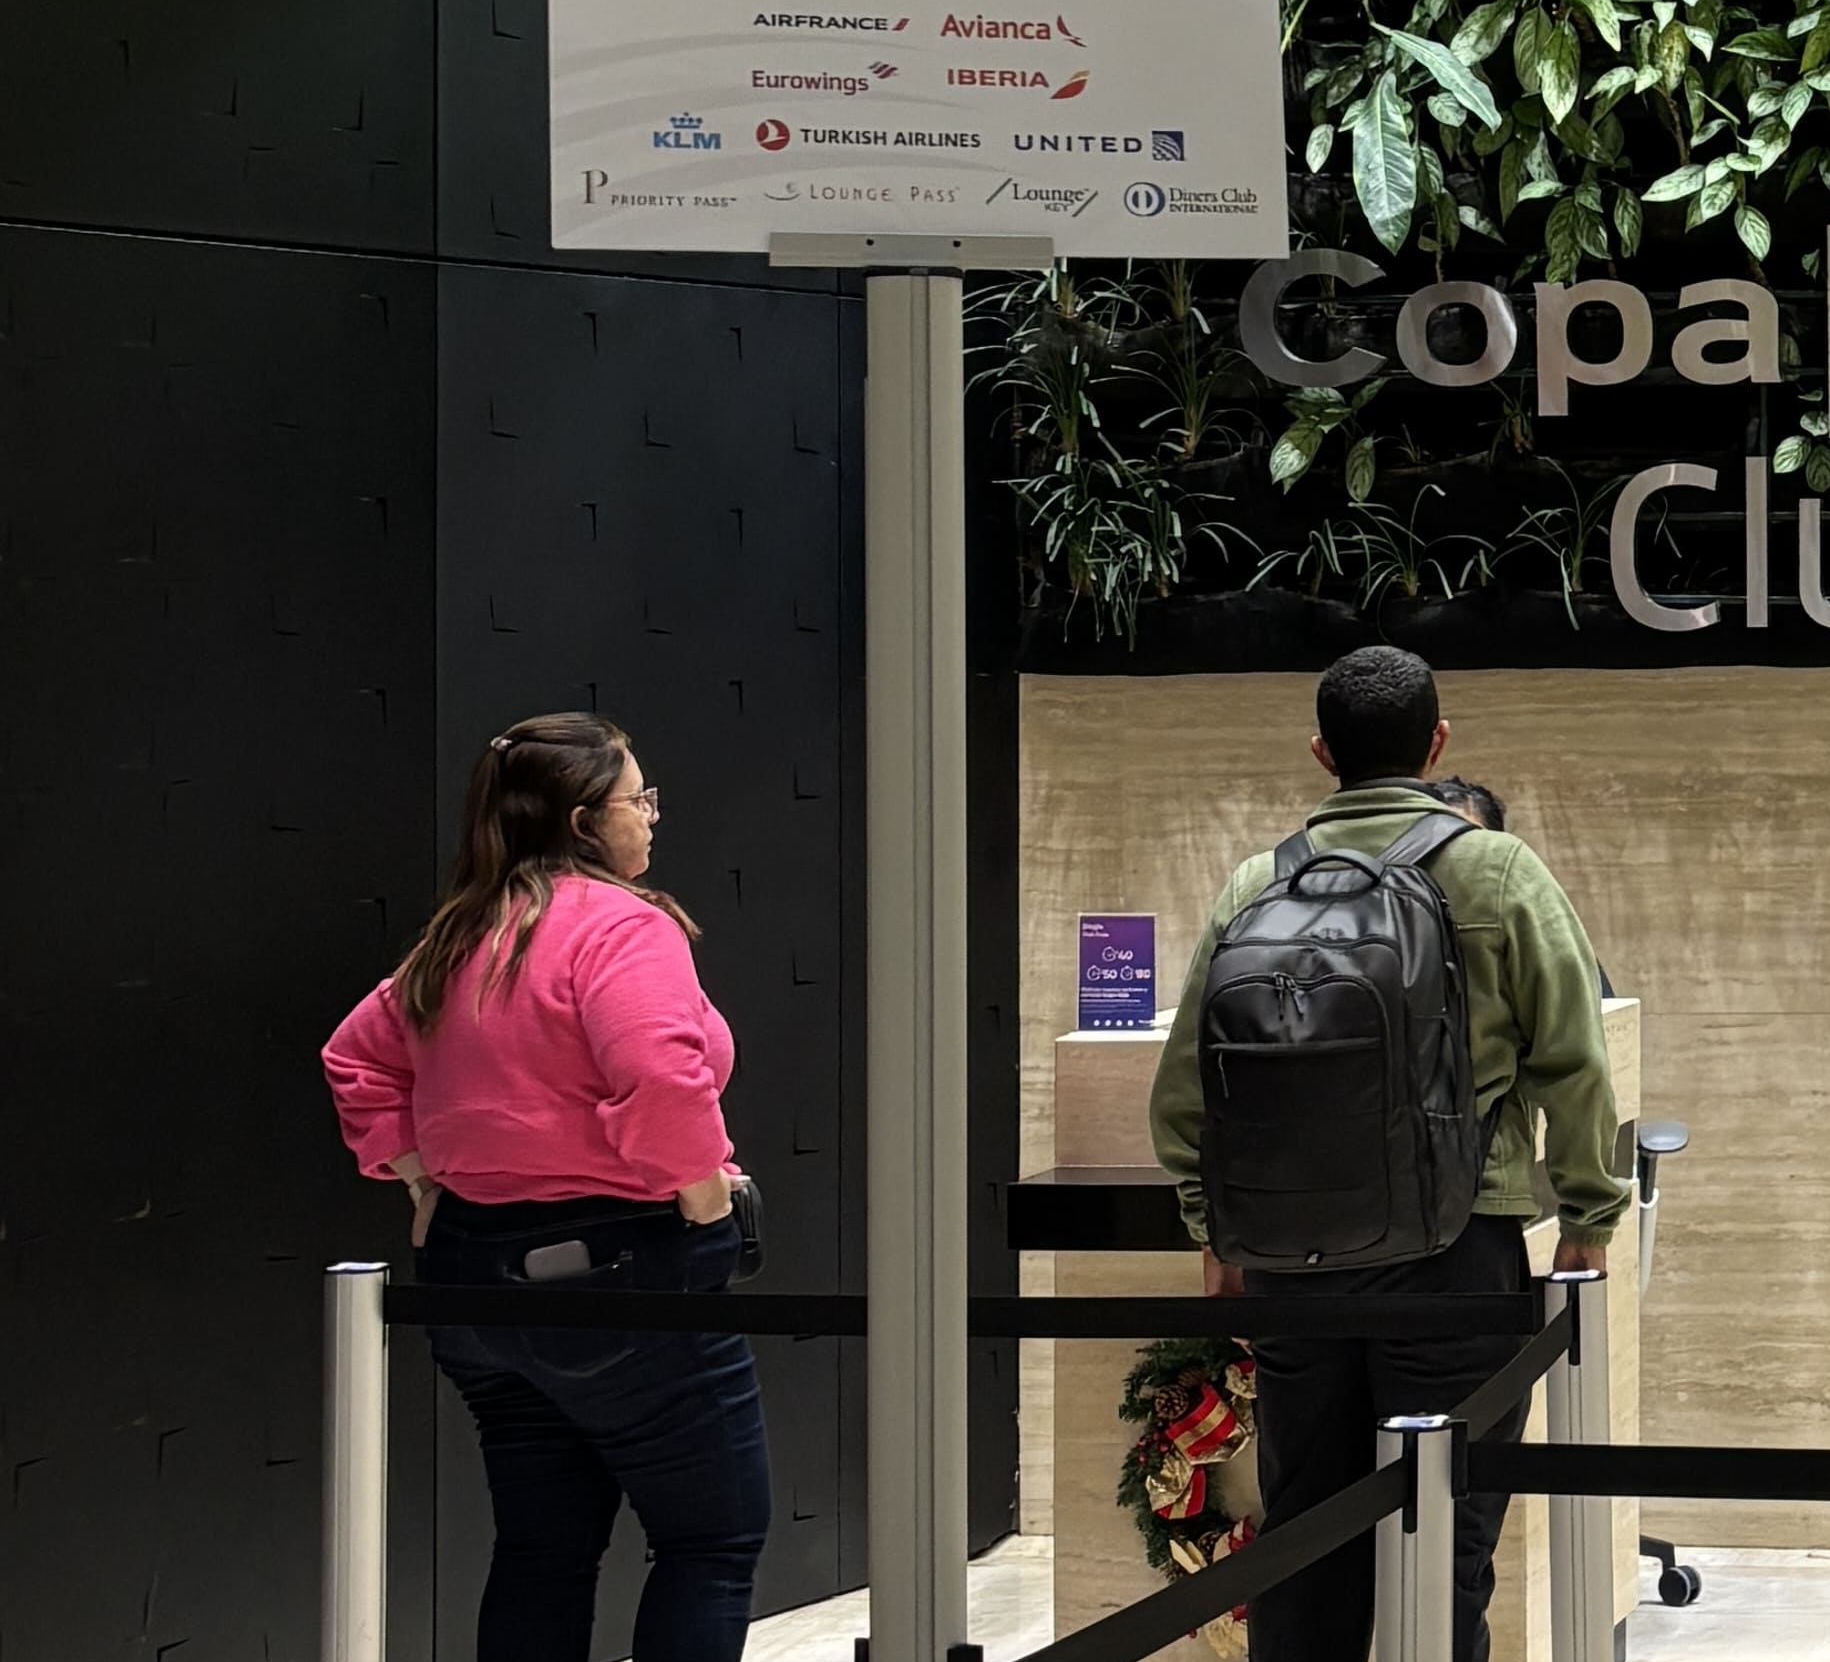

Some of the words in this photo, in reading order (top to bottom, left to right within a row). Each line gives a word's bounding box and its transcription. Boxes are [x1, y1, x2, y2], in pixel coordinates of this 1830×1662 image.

[753, 13, 889, 31] AIRFRANCE
[940, 14, 1052, 41] Avianca
[751, 70, 870, 96] Eurowings
[947, 68, 1050, 88] IBERIA
[653, 130, 722, 151] KLM
[800, 128, 888, 146] TURKISH
[893, 131, 981, 148] AIRLINES
[1014, 134, 1143, 153] UNITED
[611, 194, 686, 207] PRIORITY
[810, 183, 892, 202] LOUNGE
[910, 186, 956, 203] PASS
[1012, 183, 1085, 206] Lounge
[1169, 187, 1218, 203] Diners
[1221, 187, 1257, 203] Club
[1238, 247, 1783, 417] Copa
